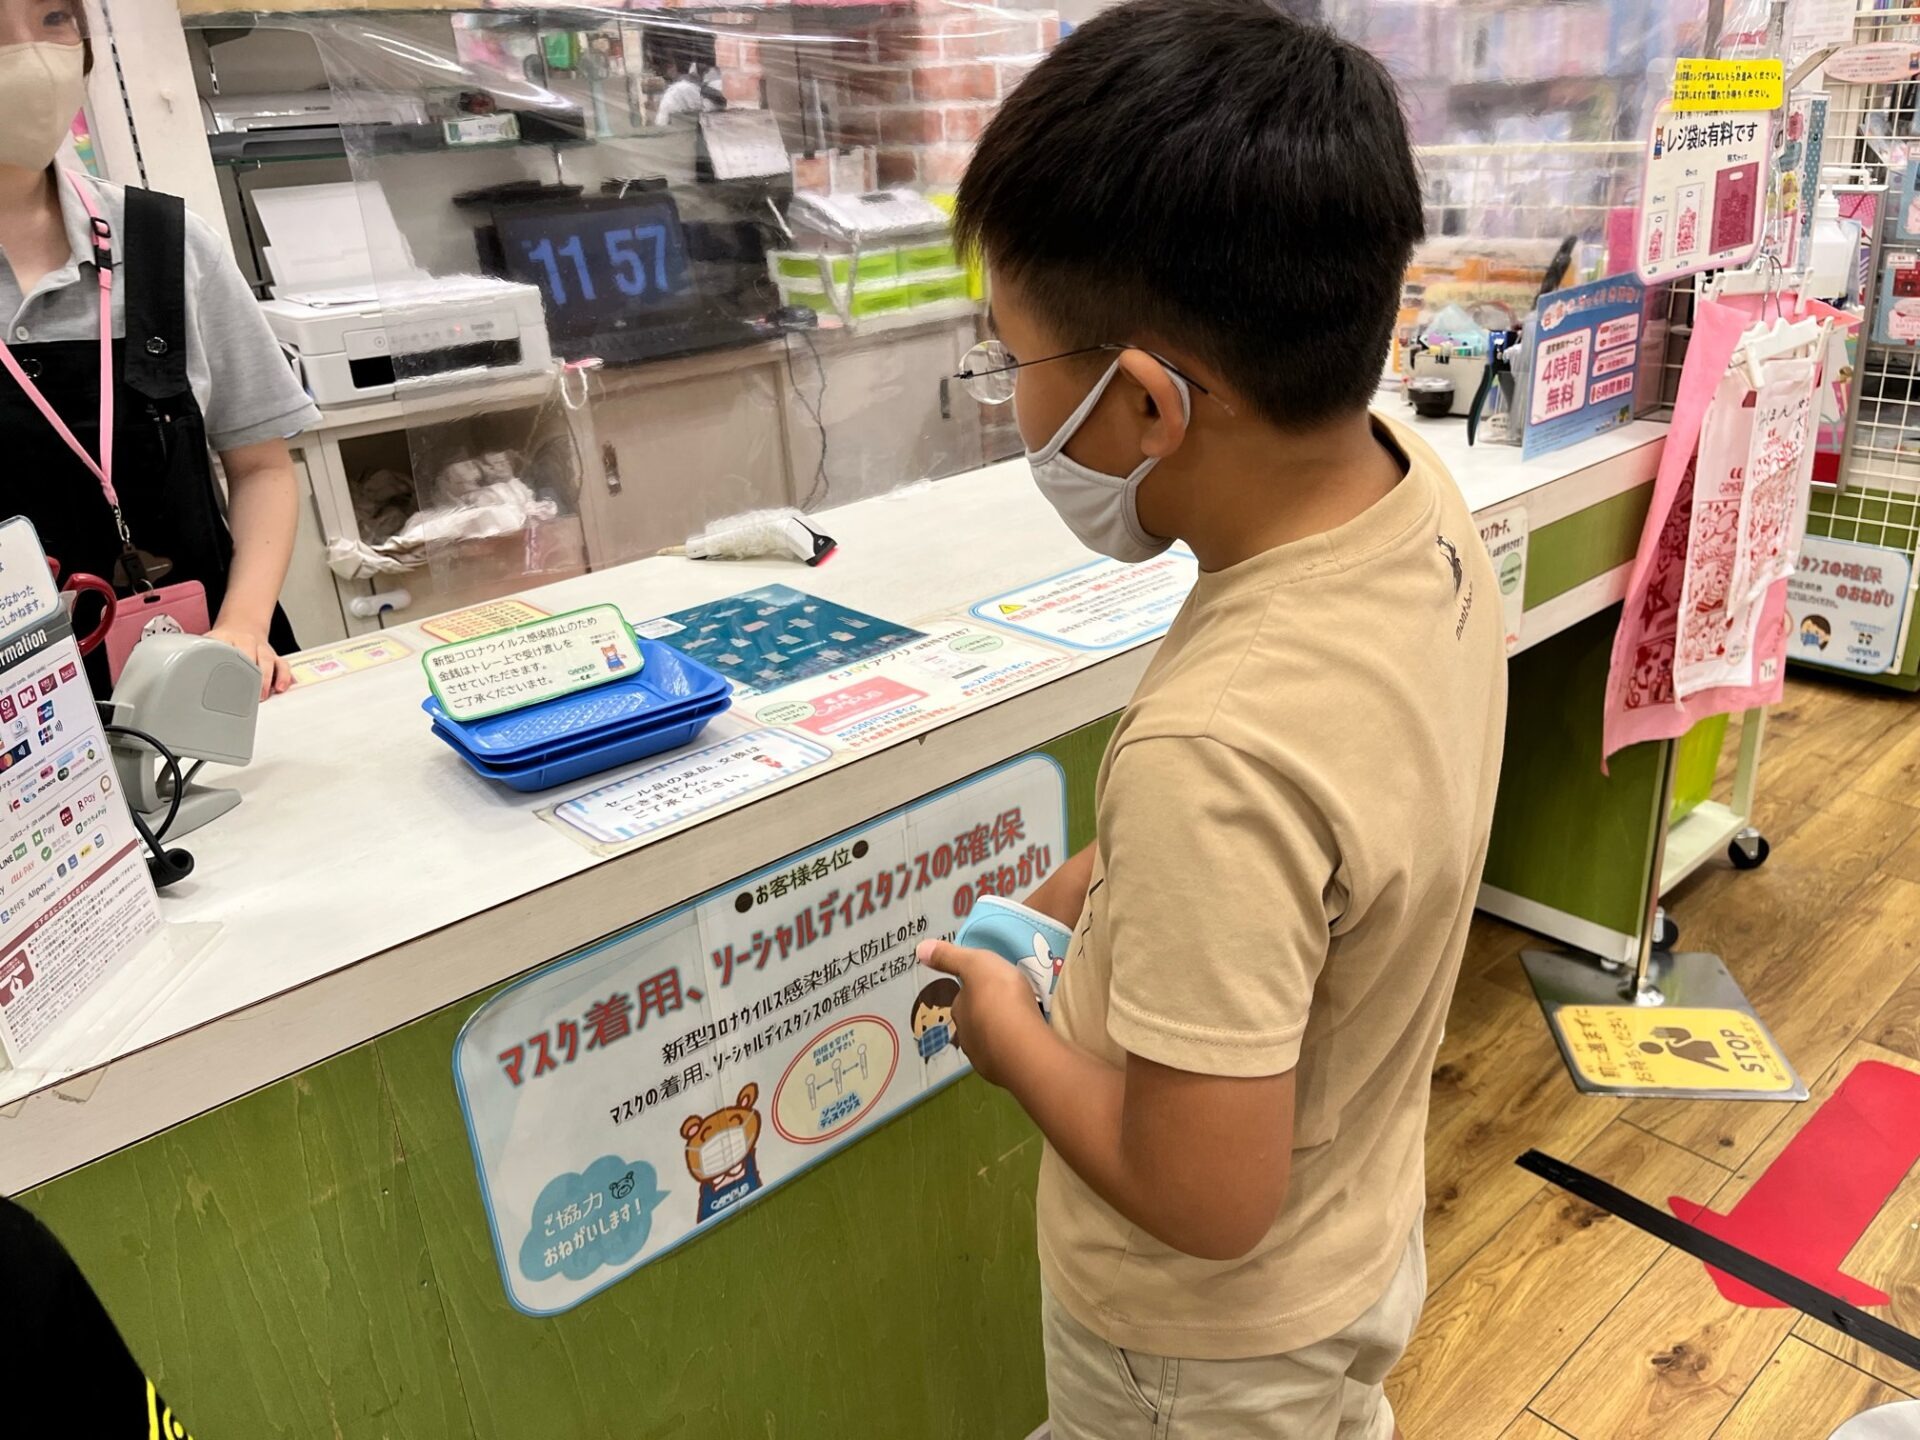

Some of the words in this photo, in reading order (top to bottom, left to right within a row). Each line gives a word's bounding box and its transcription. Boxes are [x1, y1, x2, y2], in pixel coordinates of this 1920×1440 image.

[1667, 119, 1758, 153] レジ袋は有料です
[529, 234, 597, 306] 11
[604, 223, 670, 297] 57
[1542, 349, 1582, 384] 4時間
[1545, 379, 1575, 415] 無料
[1835, 583, 1895, 609] のおねがい
[432, 616, 598, 668] 新型コロナウイルス感染防止のため
[438, 639, 574, 682] 金銭はトレー上で受け渡しを
[446, 662, 548, 695] させていただきます。
[453, 677, 554, 710] ご了承くださいませ。
[620, 778, 708, 813] できません。
[634, 772, 750, 820] ご了承ください。
[756, 847, 853, 906] お客様各位
[498, 806, 1027, 1088] マスク着用、ソーシャルディスタンスの確保
[661, 915, 928, 1064] 新型コロナウイルス感染拡大防止のため
[1719, 1028, 1765, 1074] STOP
[819, 1099, 862, 1129] ディスタンス
[821, 1091, 857, 1118] ソーシャル
[543, 1197, 642, 1269] おねがいします！
[544, 1191, 604, 1238] ご協力
